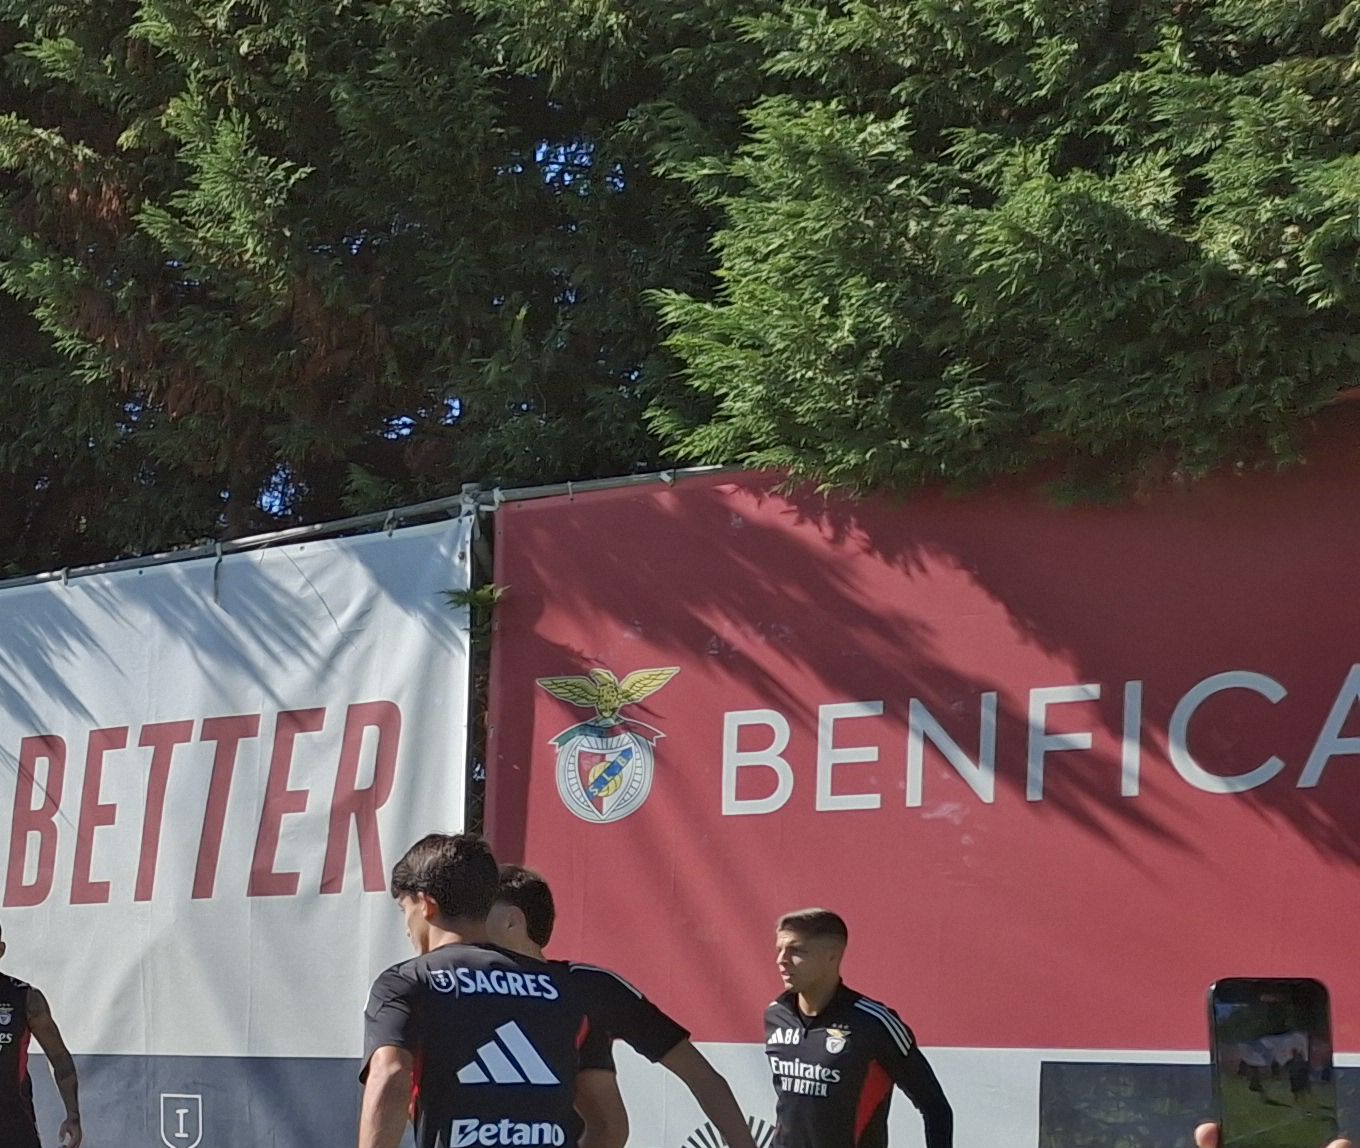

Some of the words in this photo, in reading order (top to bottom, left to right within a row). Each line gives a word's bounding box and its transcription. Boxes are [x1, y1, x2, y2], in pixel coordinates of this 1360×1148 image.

[2, 700, 402, 907] BETTER
[456, 967, 559, 1000] SAGRES
[784, 1028, 800, 1045] 86
[769, 1056, 841, 1084] Emirates
[793, 1078, 829, 1097] BETTER
[450, 1118, 565, 1148] Betano
